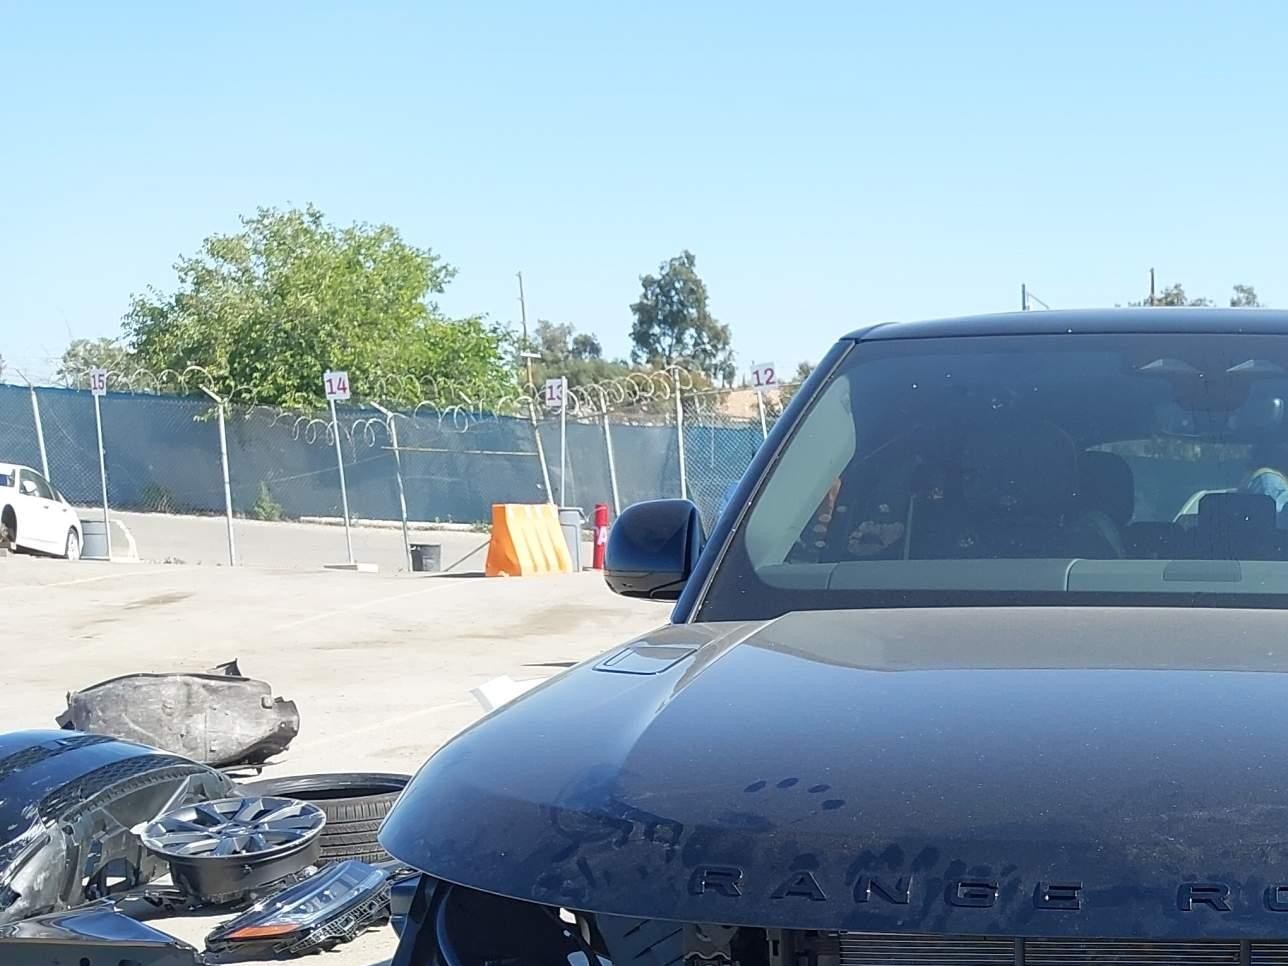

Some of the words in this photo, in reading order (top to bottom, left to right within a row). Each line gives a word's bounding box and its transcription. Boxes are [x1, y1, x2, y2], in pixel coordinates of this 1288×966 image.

[91, 374, 105, 390] 15
[326, 376, 348, 395] 14
[752, 367, 777, 388] 12
[688, 864, 1082, 911] RANGE
